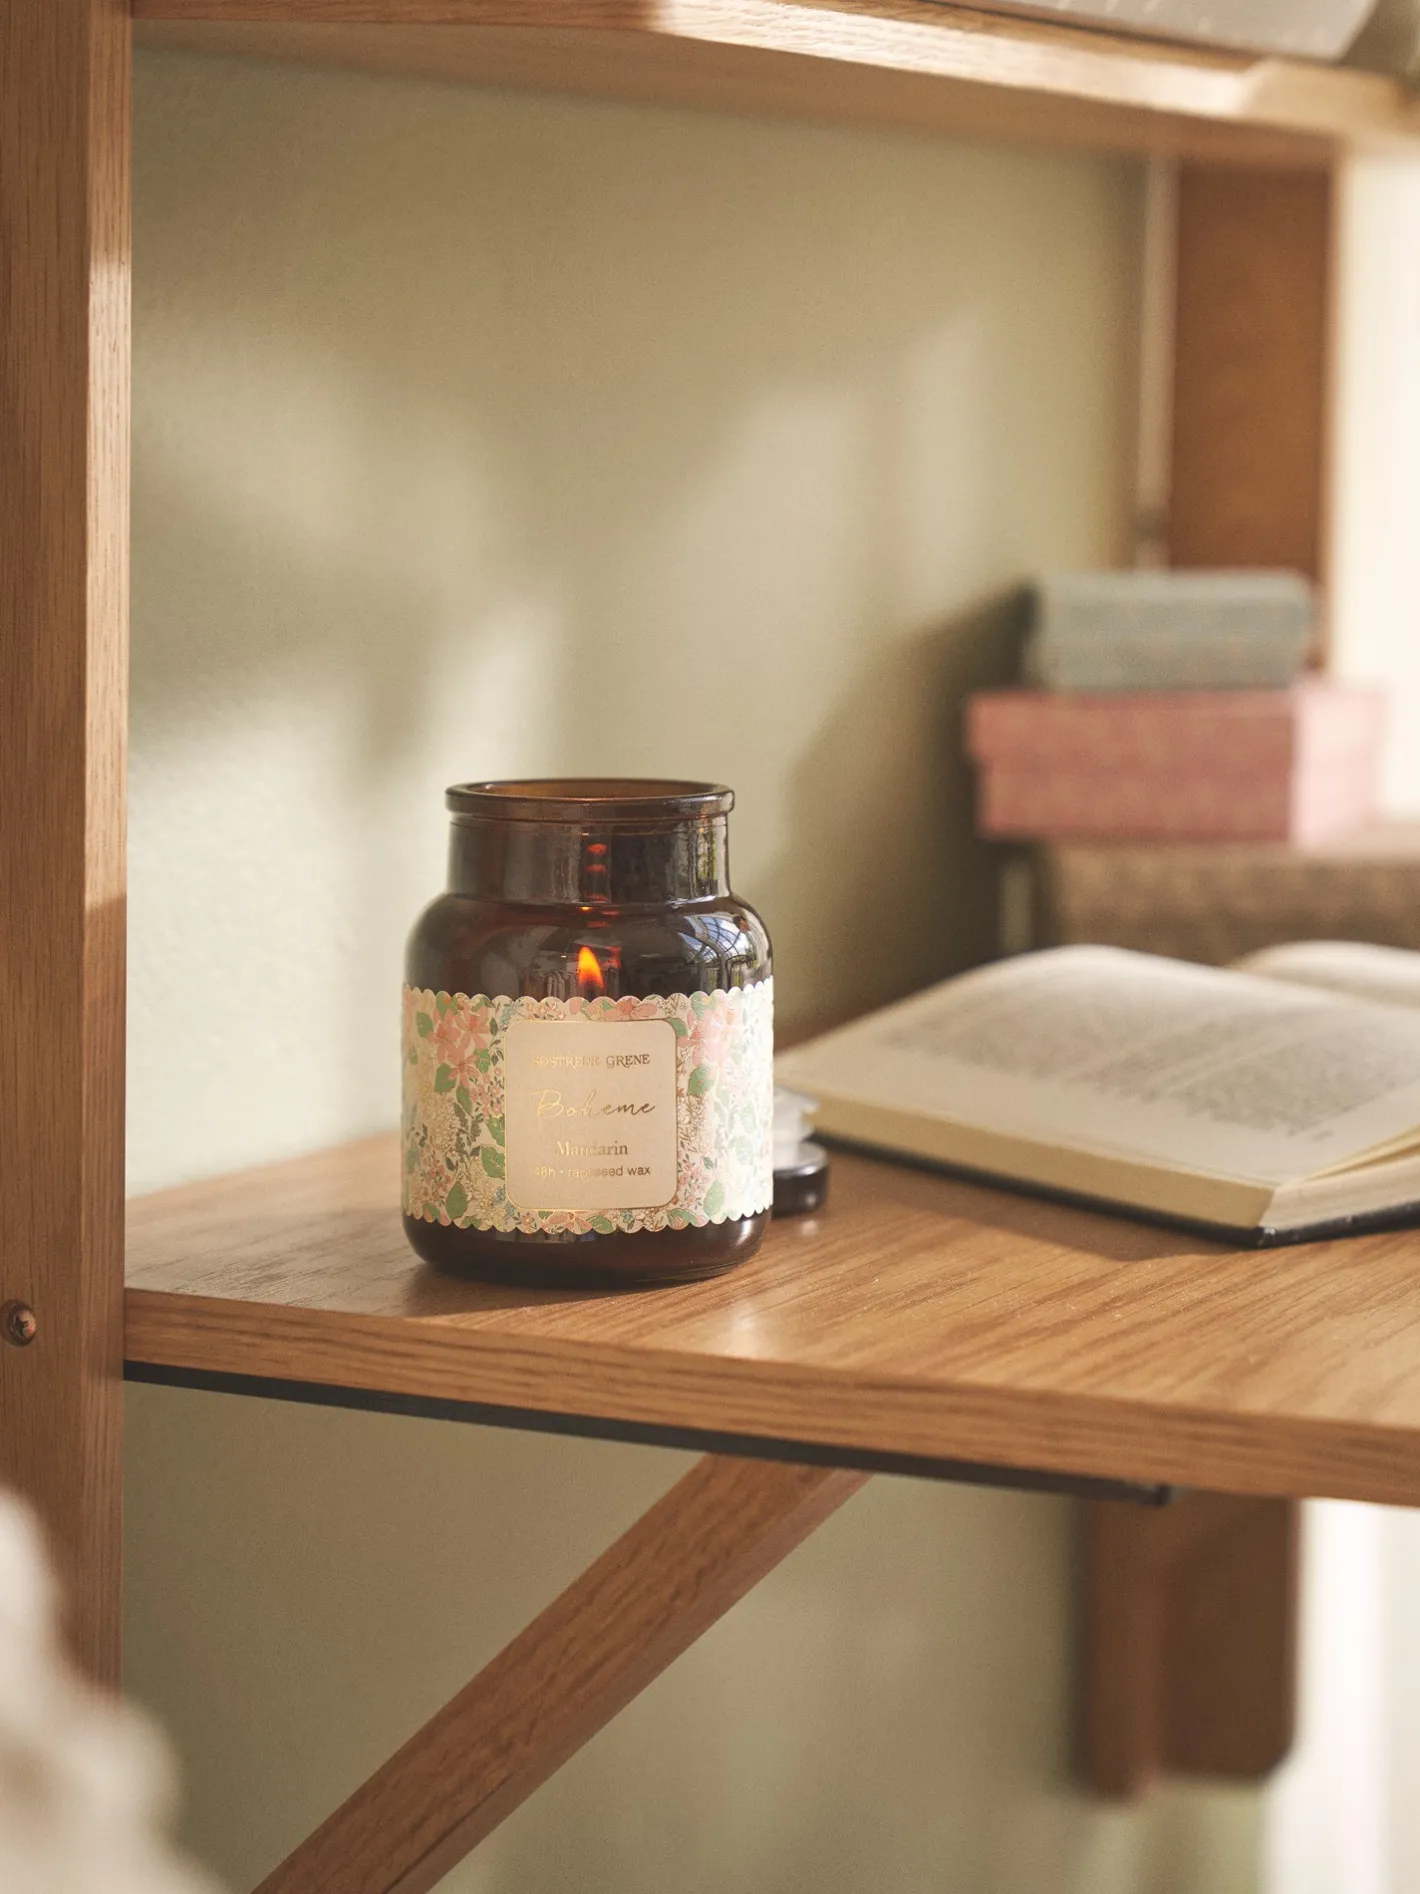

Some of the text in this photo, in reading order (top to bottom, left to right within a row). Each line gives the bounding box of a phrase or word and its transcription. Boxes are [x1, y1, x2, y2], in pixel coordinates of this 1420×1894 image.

[606, 1054, 650, 1069] GRENE
[530, 1088, 657, 1118] Boheme
[556, 1141, 628, 1156] Mandarin
[535, 1166, 556, 1178] 48h
[628, 1165, 651, 1176] wax
